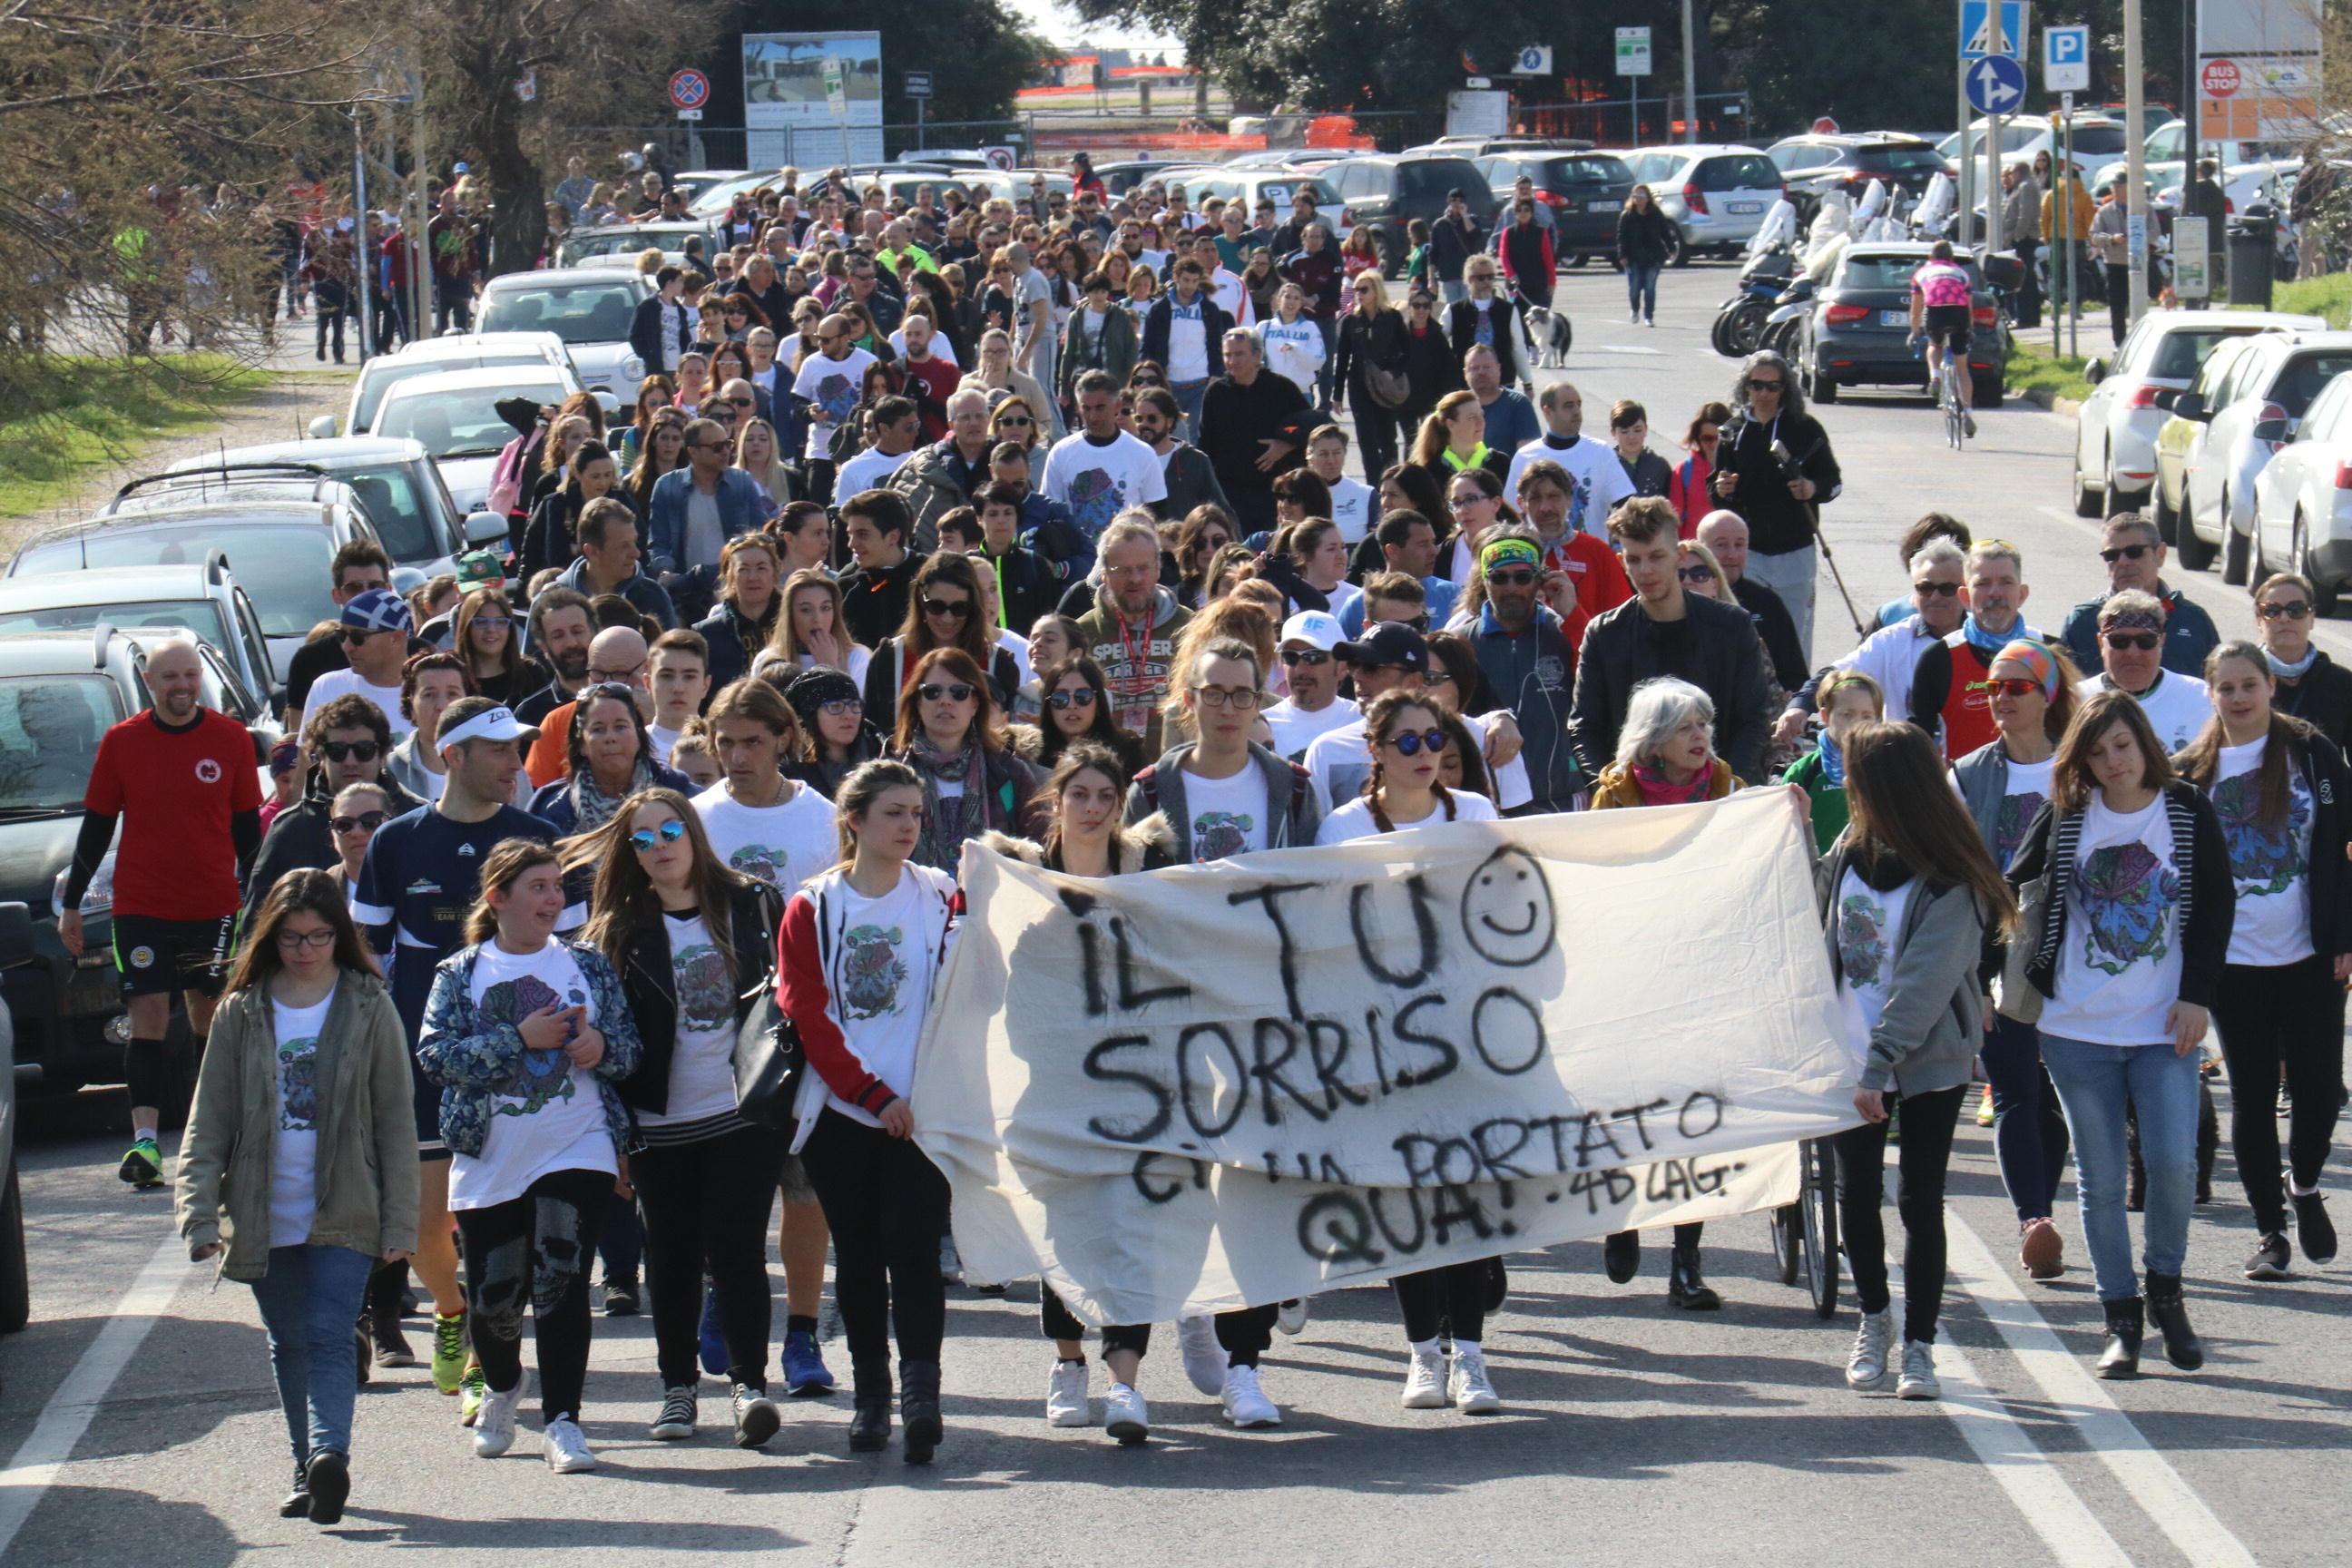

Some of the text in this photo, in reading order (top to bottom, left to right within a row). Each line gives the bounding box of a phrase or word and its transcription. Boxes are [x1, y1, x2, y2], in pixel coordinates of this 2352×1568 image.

[2056, 35, 2077, 61] P
[2208, 66, 2235, 77] BUS
[2206, 79, 2239, 89] STOP
[2211, 102, 2218, 112] 1
[1093, 640, 1172, 661] SPEER
[1103, 663, 1162, 677] GARGE
[1063, 874, 1443, 1023] IL TU
[1083, 986, 1544, 1145] SORRISO
[1392, 1092, 1721, 1191] PORTATO
